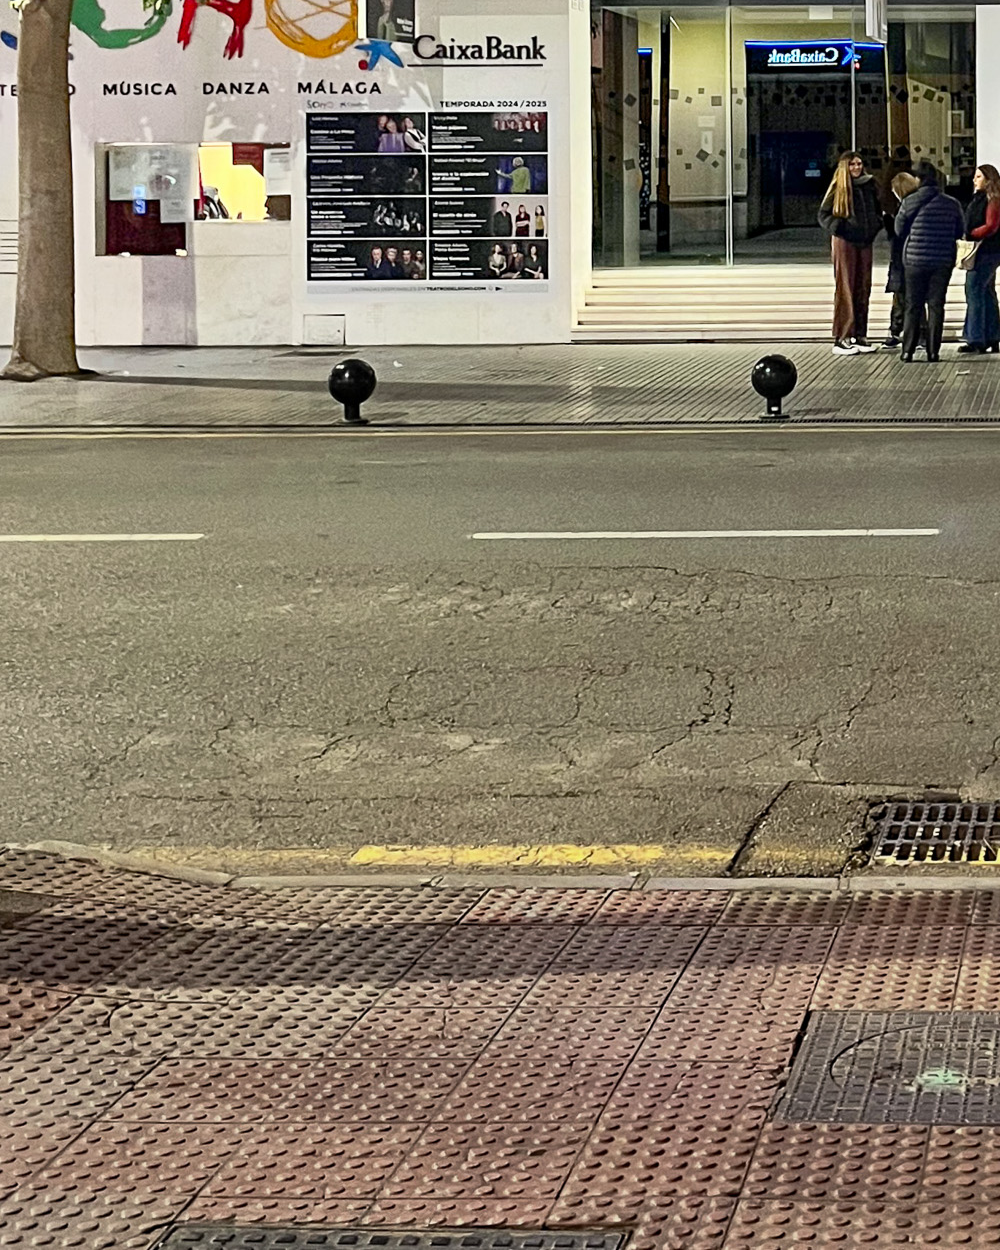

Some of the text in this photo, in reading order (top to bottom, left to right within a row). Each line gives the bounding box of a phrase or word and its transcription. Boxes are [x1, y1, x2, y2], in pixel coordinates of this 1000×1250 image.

[412, 35, 546, 59] CaixaBank
[0, 80, 382, 97] TEO MÚSICA DANZA MÁLAGA
